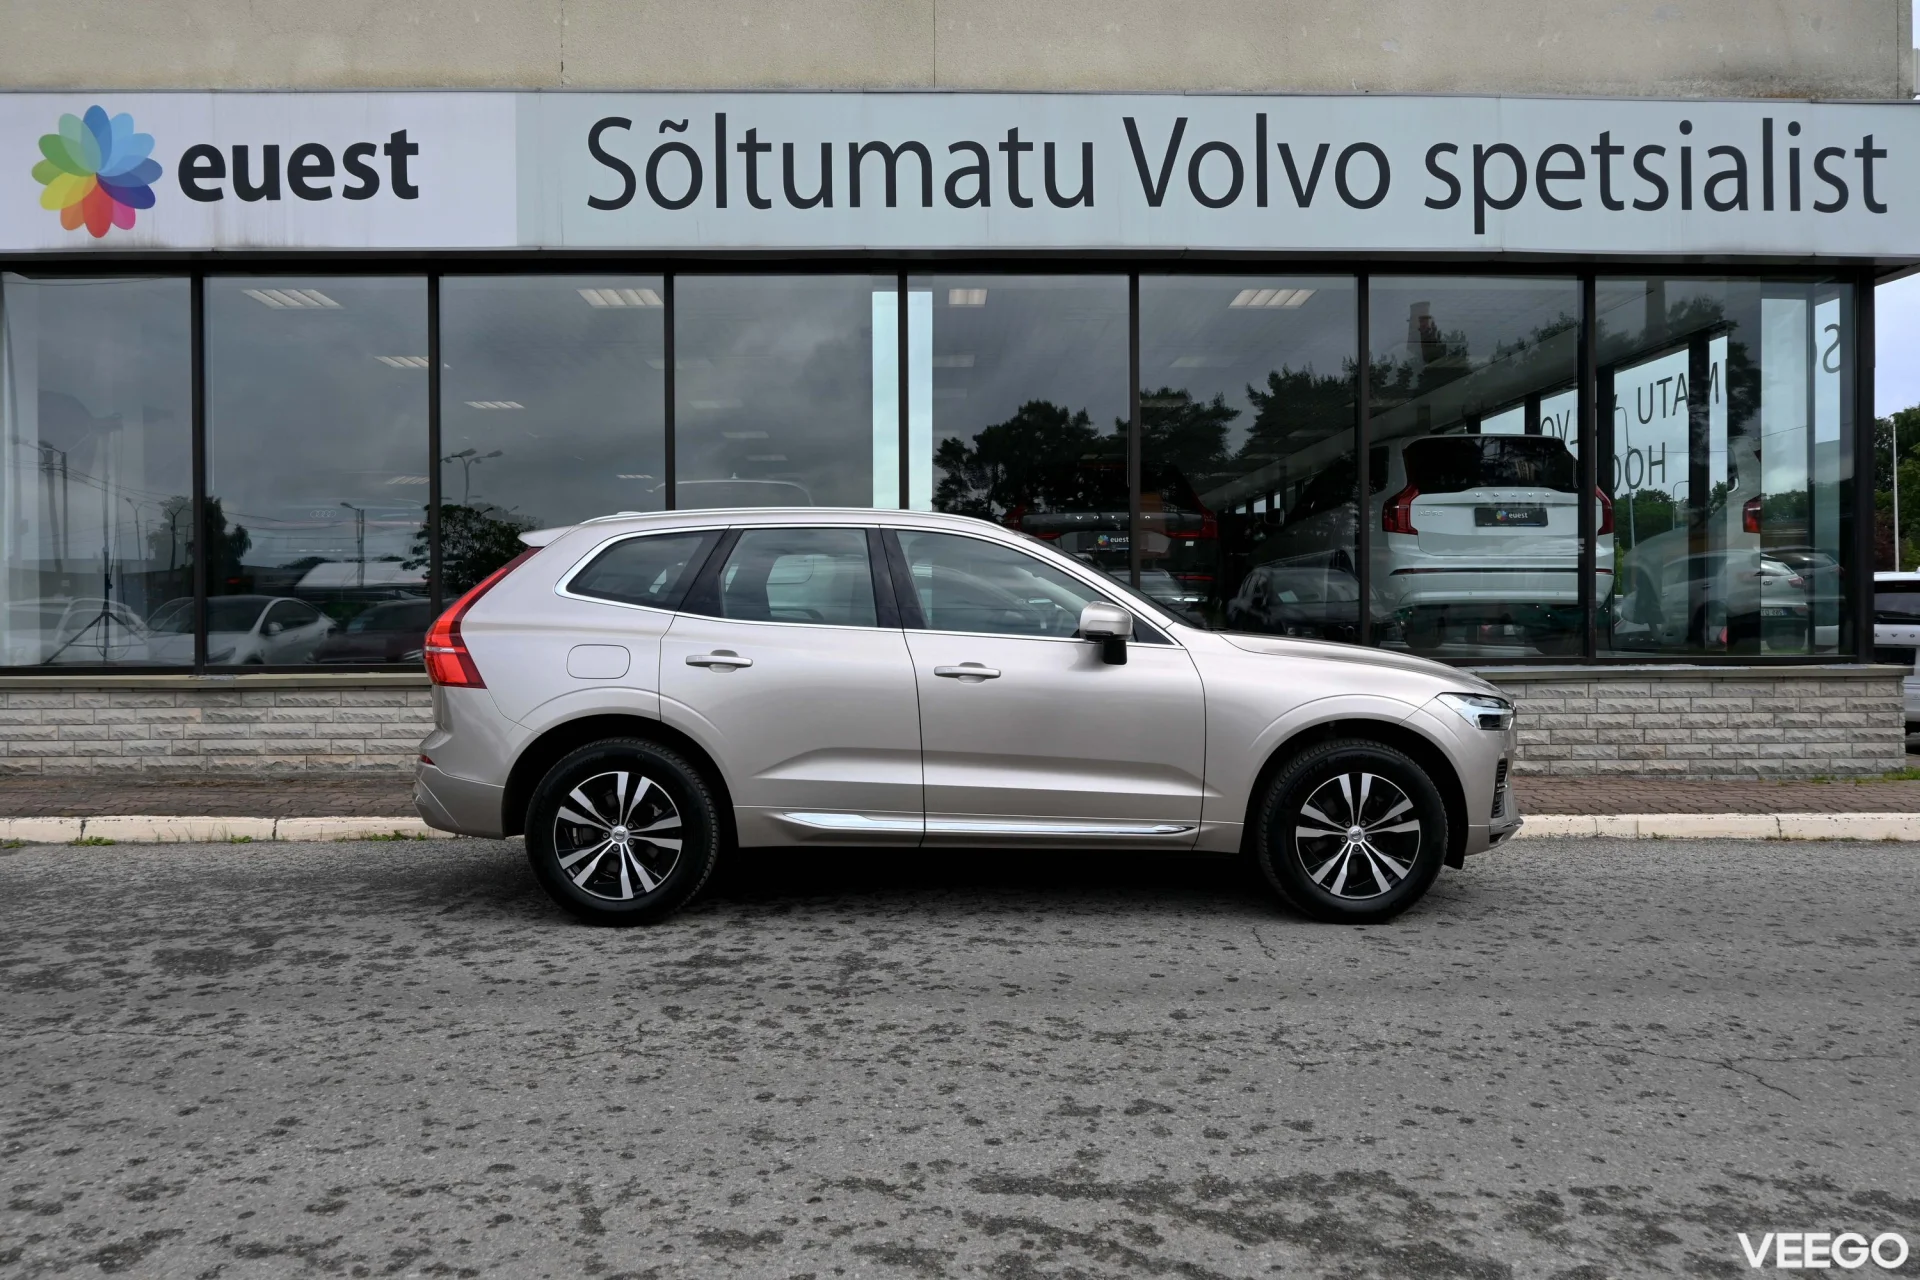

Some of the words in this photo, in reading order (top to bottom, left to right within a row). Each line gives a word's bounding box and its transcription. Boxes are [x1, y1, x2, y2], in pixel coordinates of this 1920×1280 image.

[178, 129, 419, 202] euest
[587, 112, 1095, 211] Sõltumatu
[1122, 112, 1391, 210] Volvo
[1424, 117, 1888, 235] spetsialist
